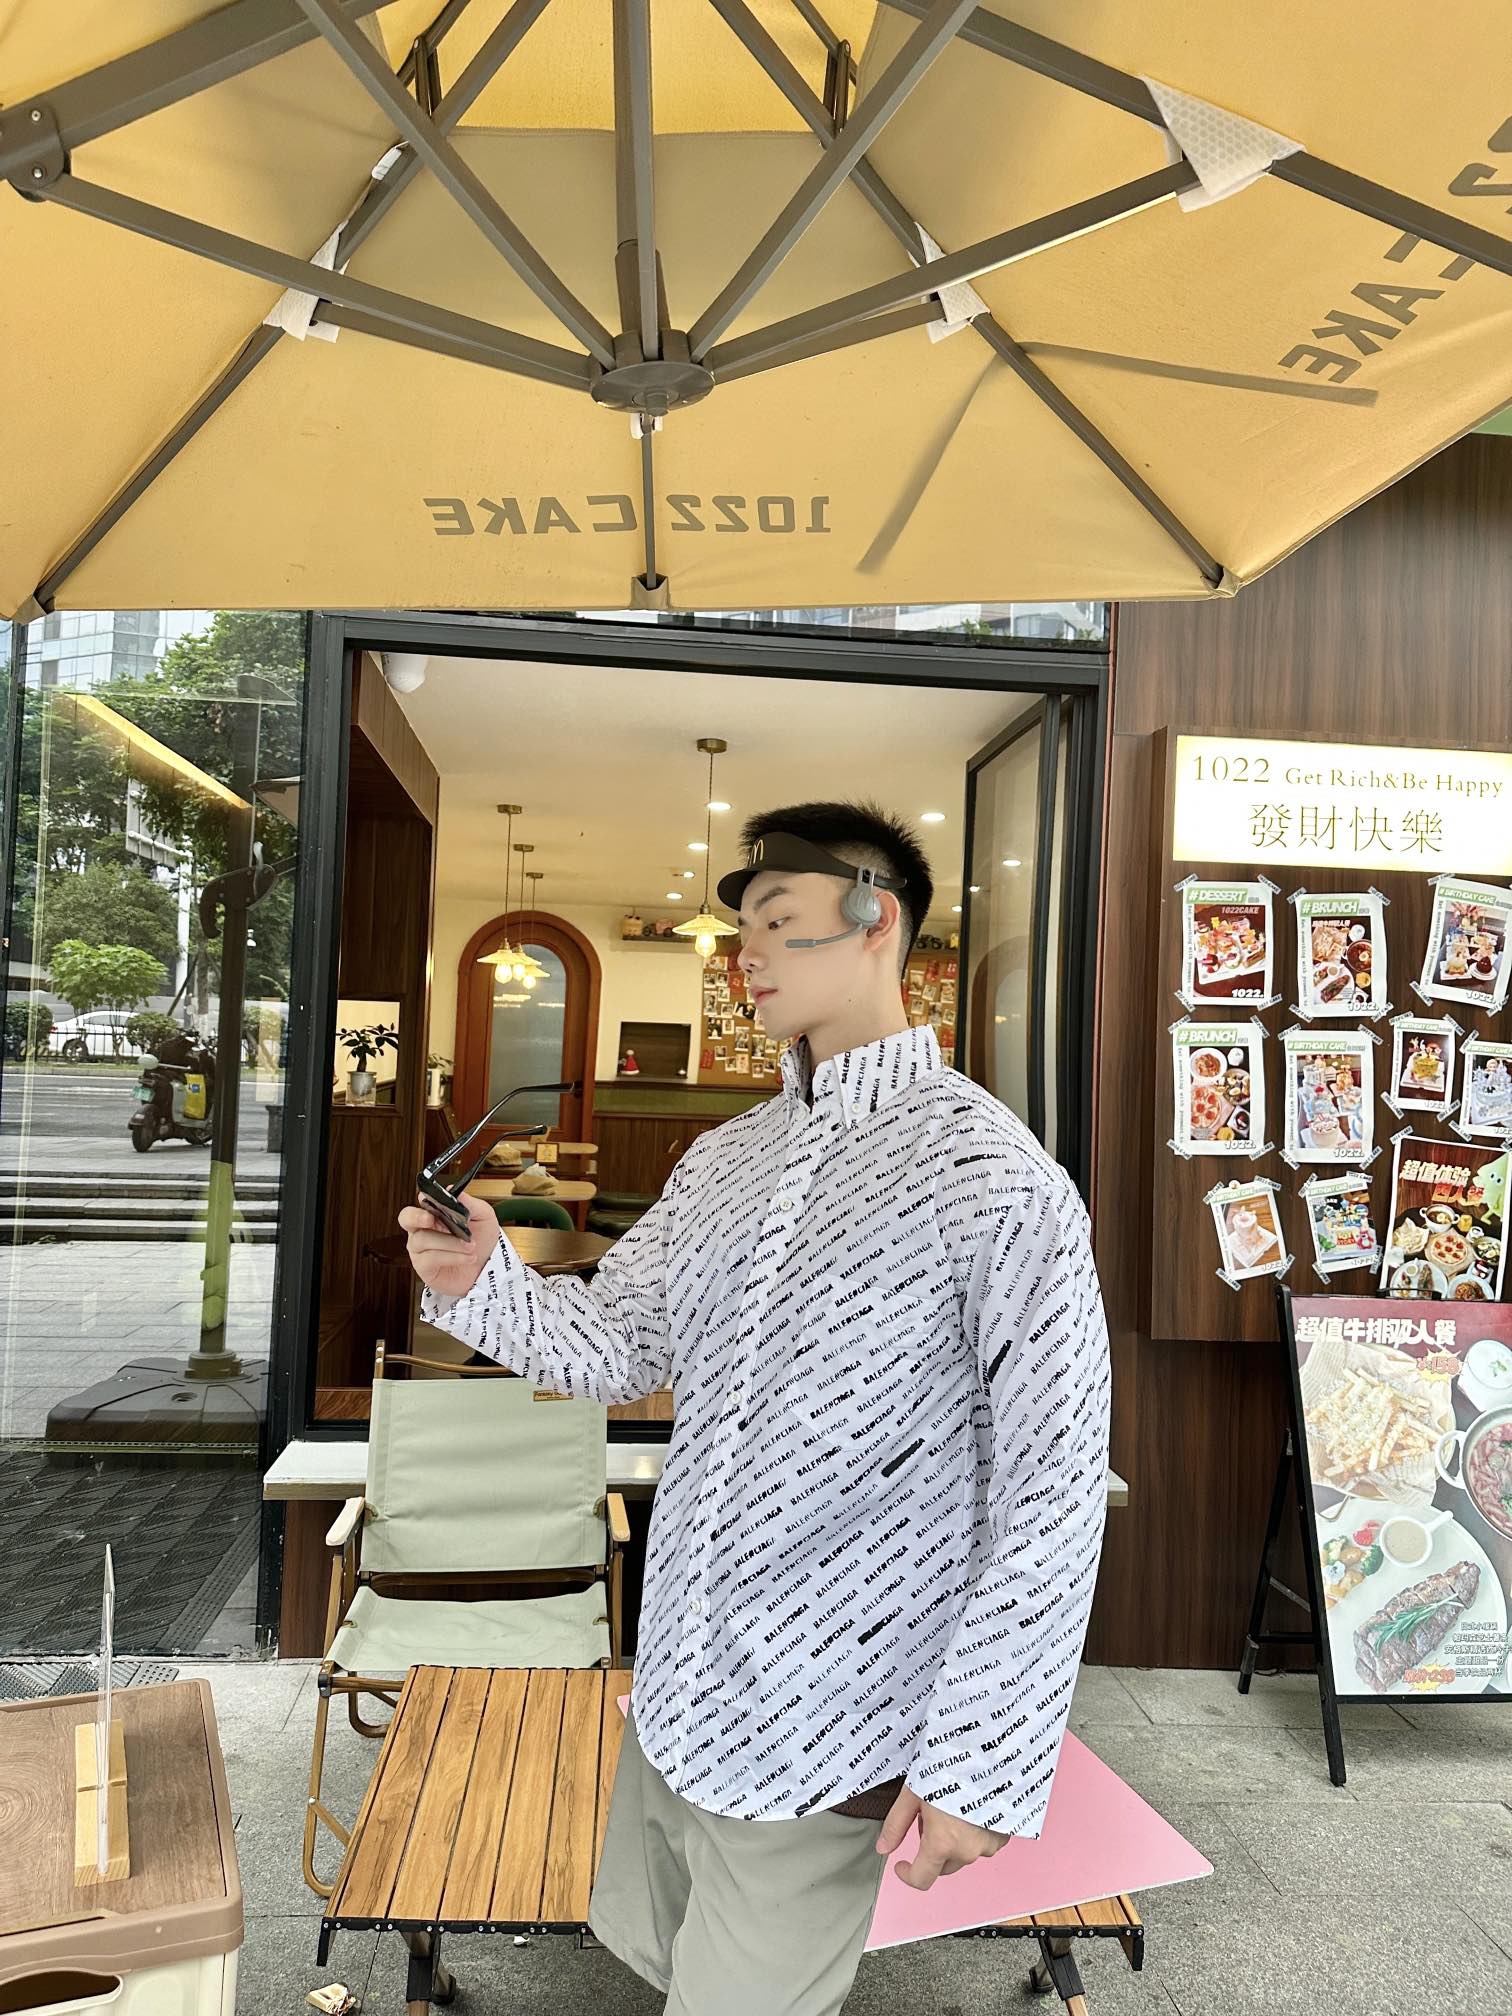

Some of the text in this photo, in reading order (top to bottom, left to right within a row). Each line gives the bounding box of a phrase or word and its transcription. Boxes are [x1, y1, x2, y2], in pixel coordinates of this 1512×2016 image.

[1194, 755, 1504, 798] 1022 Get Rich&Be Happy
[1248, 803, 1445, 855] 發財快樂
[1295, 1317, 1457, 1349] 超值牛排双人餐
